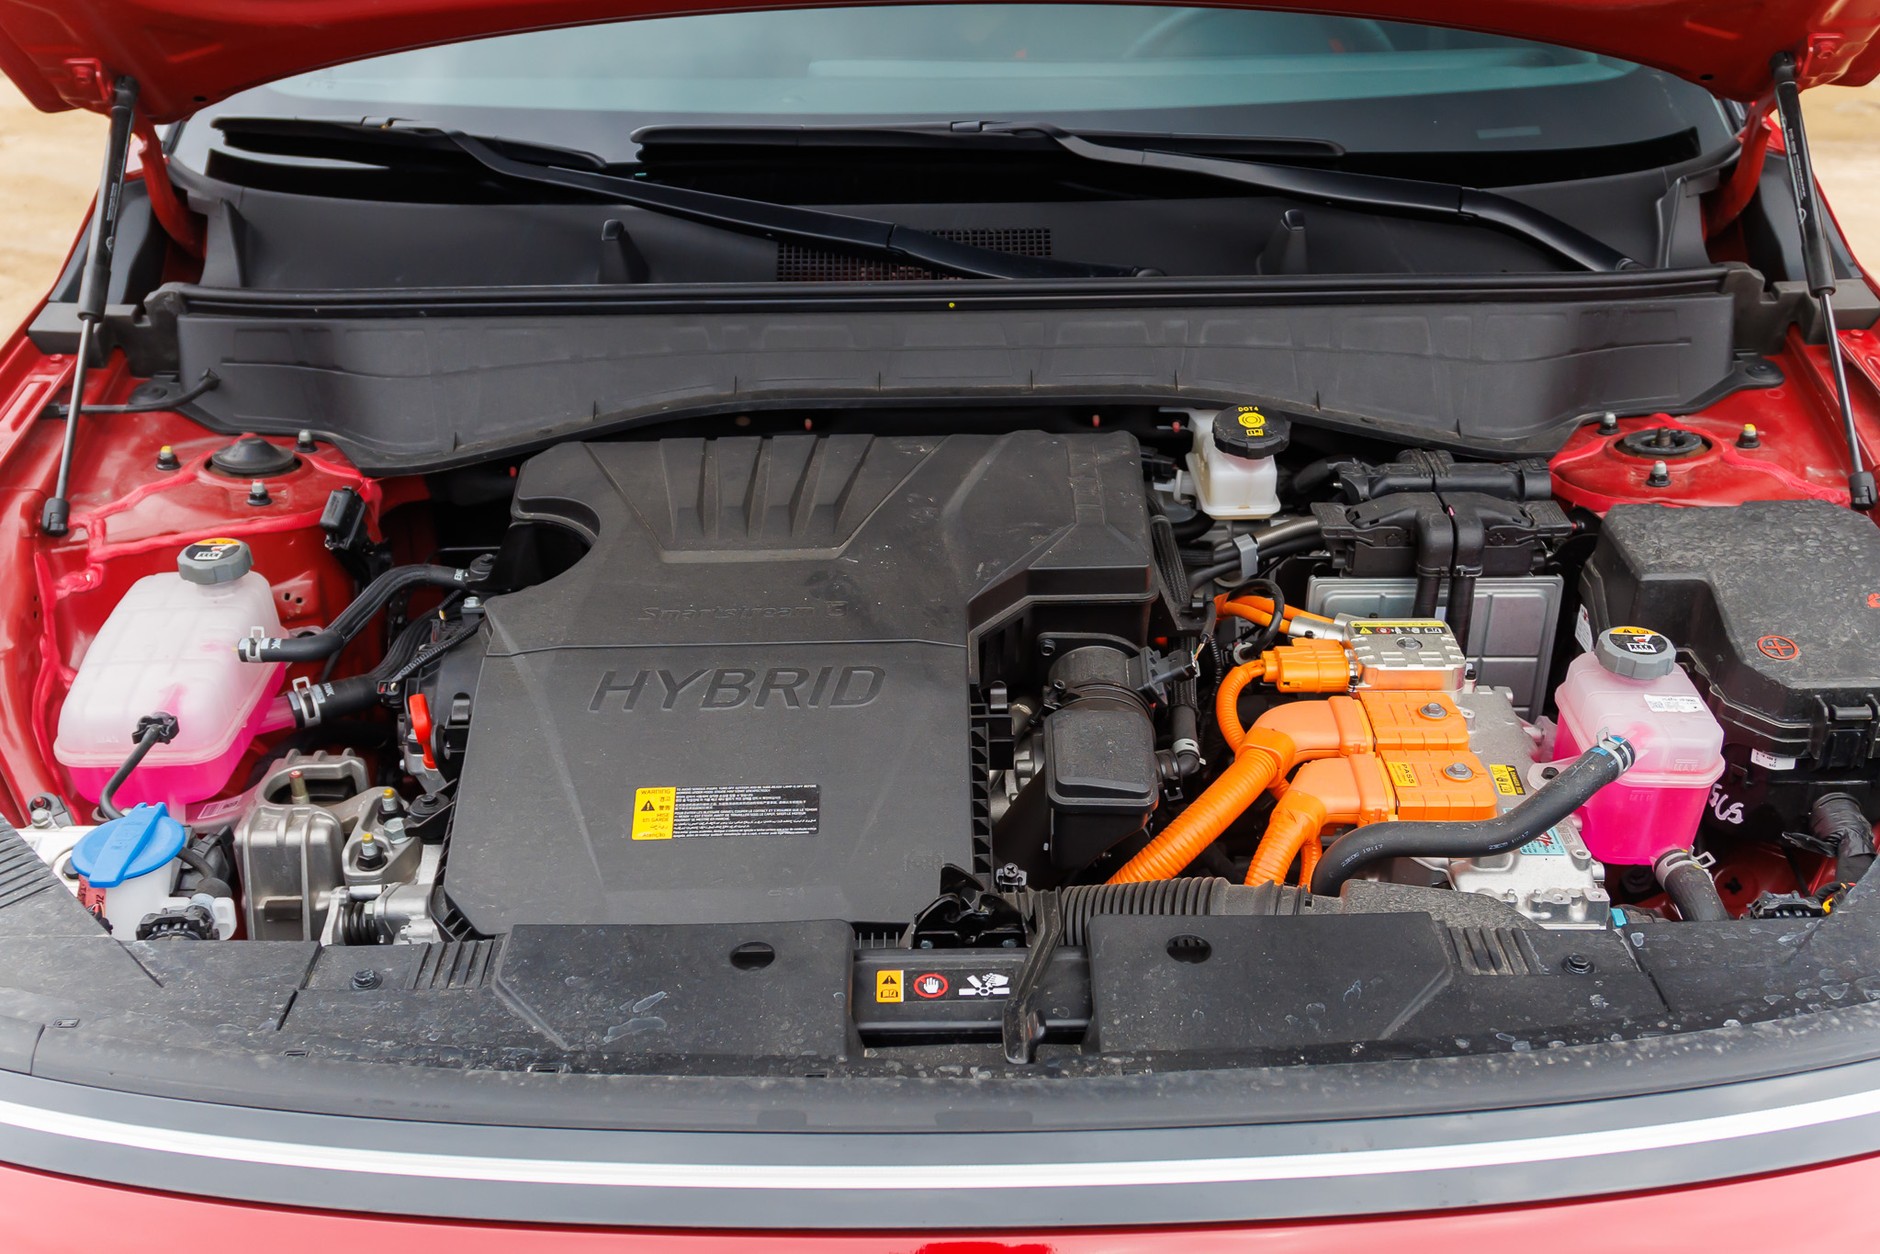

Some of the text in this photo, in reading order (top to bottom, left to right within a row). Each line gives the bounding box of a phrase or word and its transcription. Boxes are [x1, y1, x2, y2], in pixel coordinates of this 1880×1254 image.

[637, 605, 816, 621] Smartstream
[587, 665, 886, 713] HYBRID
[1401, 763, 1415, 784] PASS
